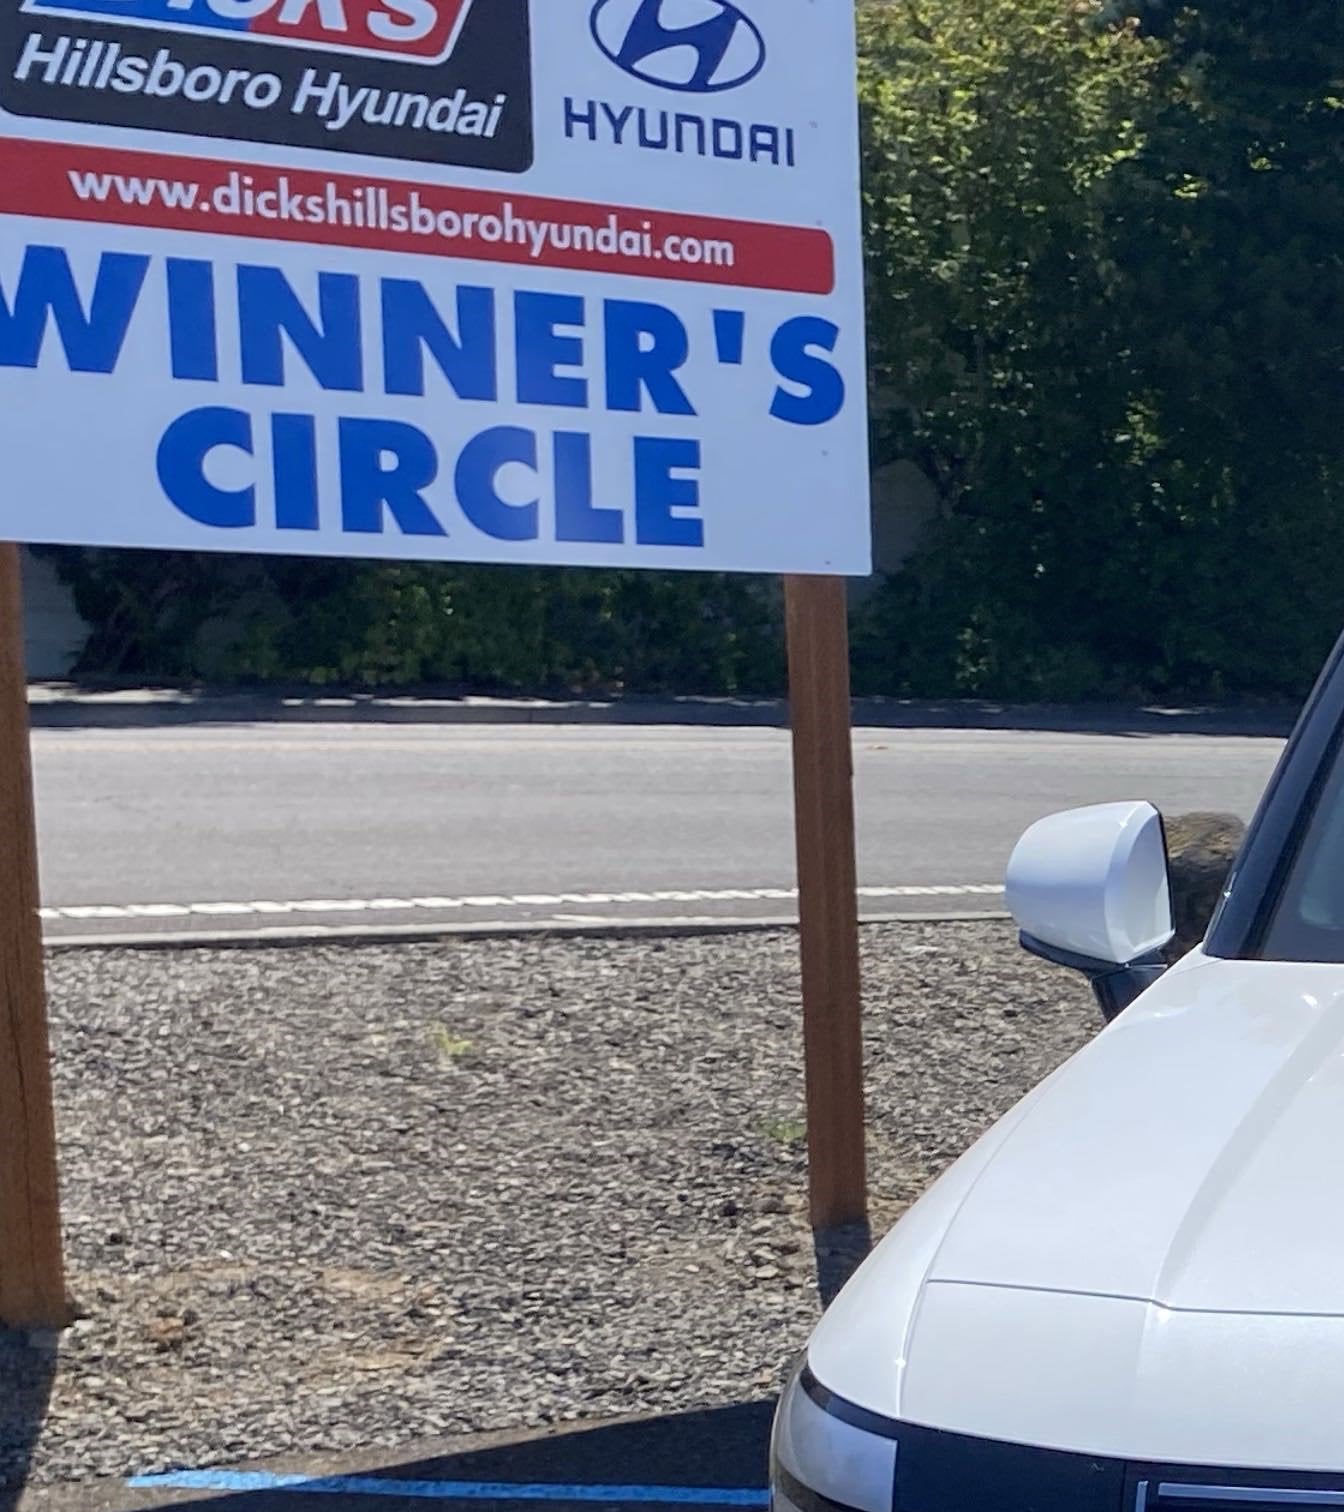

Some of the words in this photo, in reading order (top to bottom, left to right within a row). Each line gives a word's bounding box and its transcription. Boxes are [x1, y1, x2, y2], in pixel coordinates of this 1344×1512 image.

[14, 33, 281, 108] Hillsboro
[292, 68, 506, 137] Hyundai
[564, 97, 795, 167] HYUNDAI
[69, 168, 735, 267] www.dickshillsborohyundai.com
[0, 245, 845, 425] WINNER'S
[156, 406, 705, 547] CIRCLE
